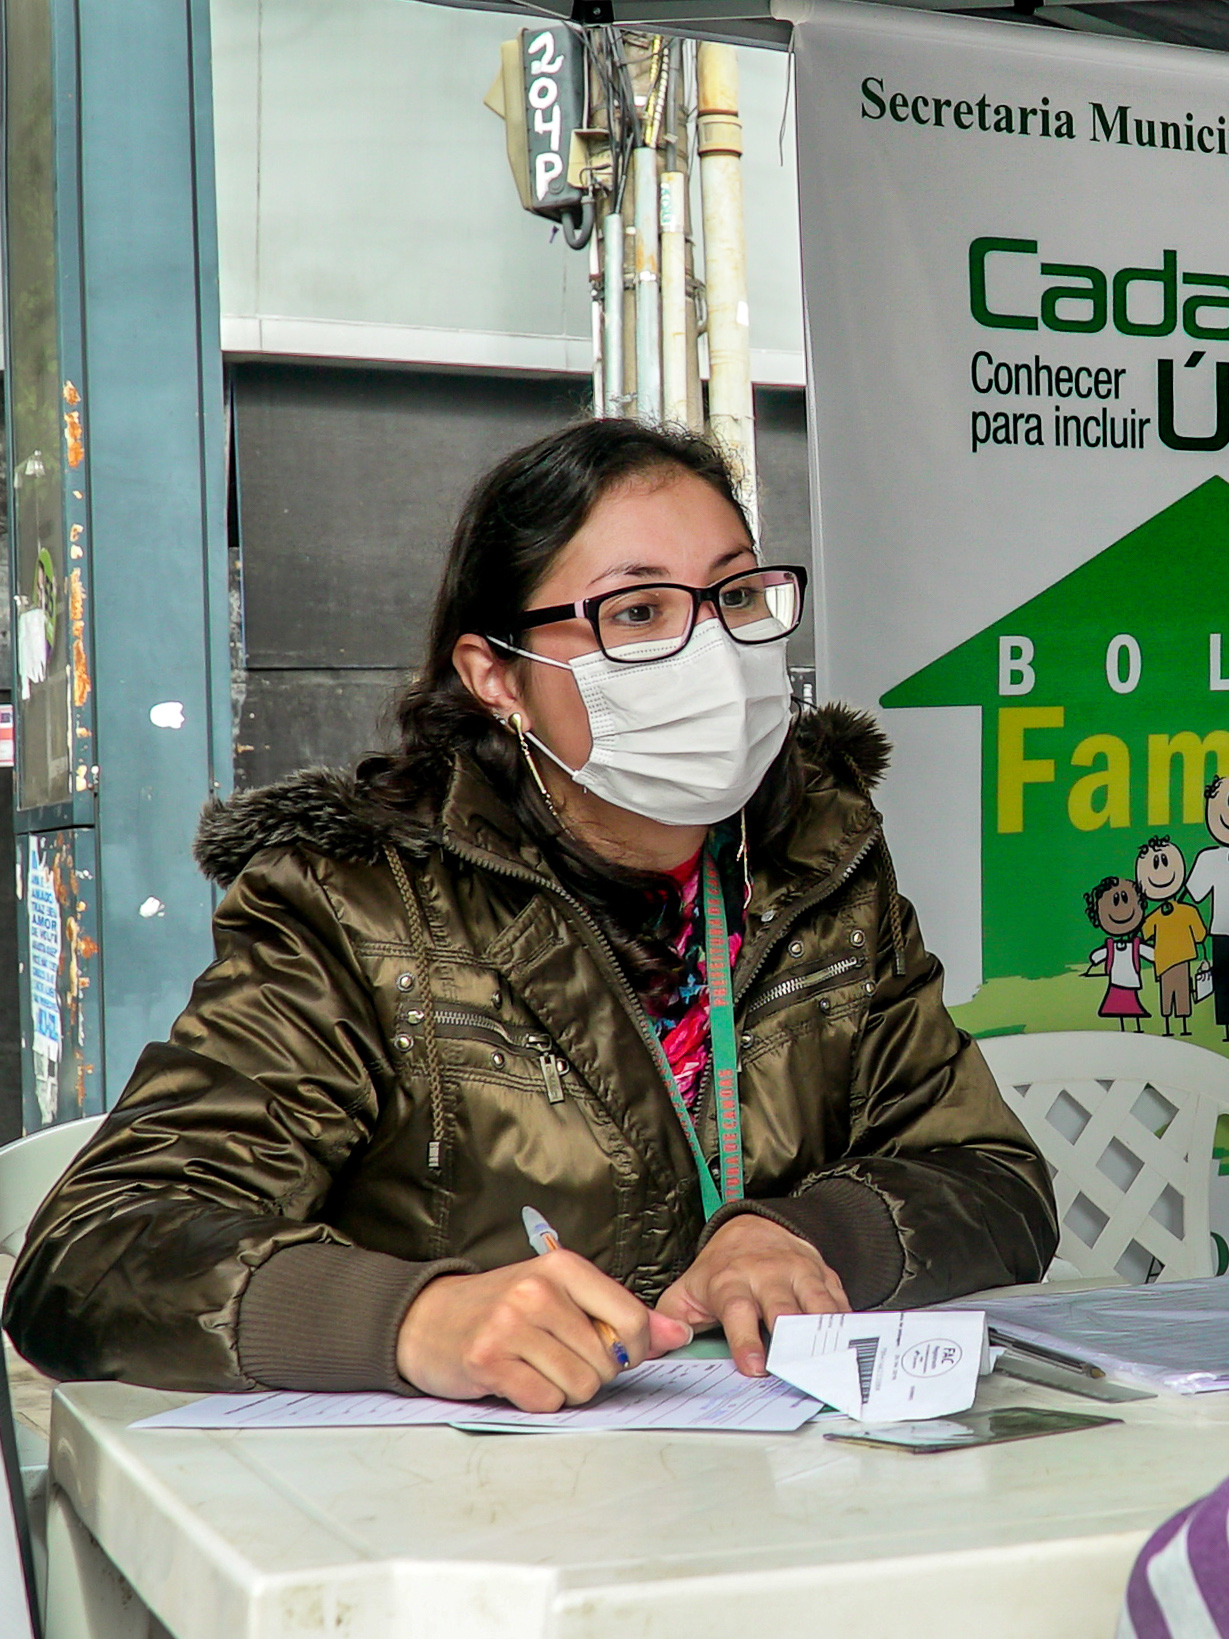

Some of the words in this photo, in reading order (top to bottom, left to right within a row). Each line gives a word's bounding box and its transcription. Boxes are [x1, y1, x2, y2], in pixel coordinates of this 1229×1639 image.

[861, 77, 1076, 139] Secretaria
[971, 350, 1127, 399] Conhecer
[971, 408, 1045, 453] para
[1054, 406, 1151, 450] incluir
[32, 914, 57, 932] AMOR
[708, 899, 722, 915] DE
[708, 919, 728, 1006] PREFEITURA
[717, 1069, 736, 1129] CANOAS
[723, 1133, 738, 1152] DE
